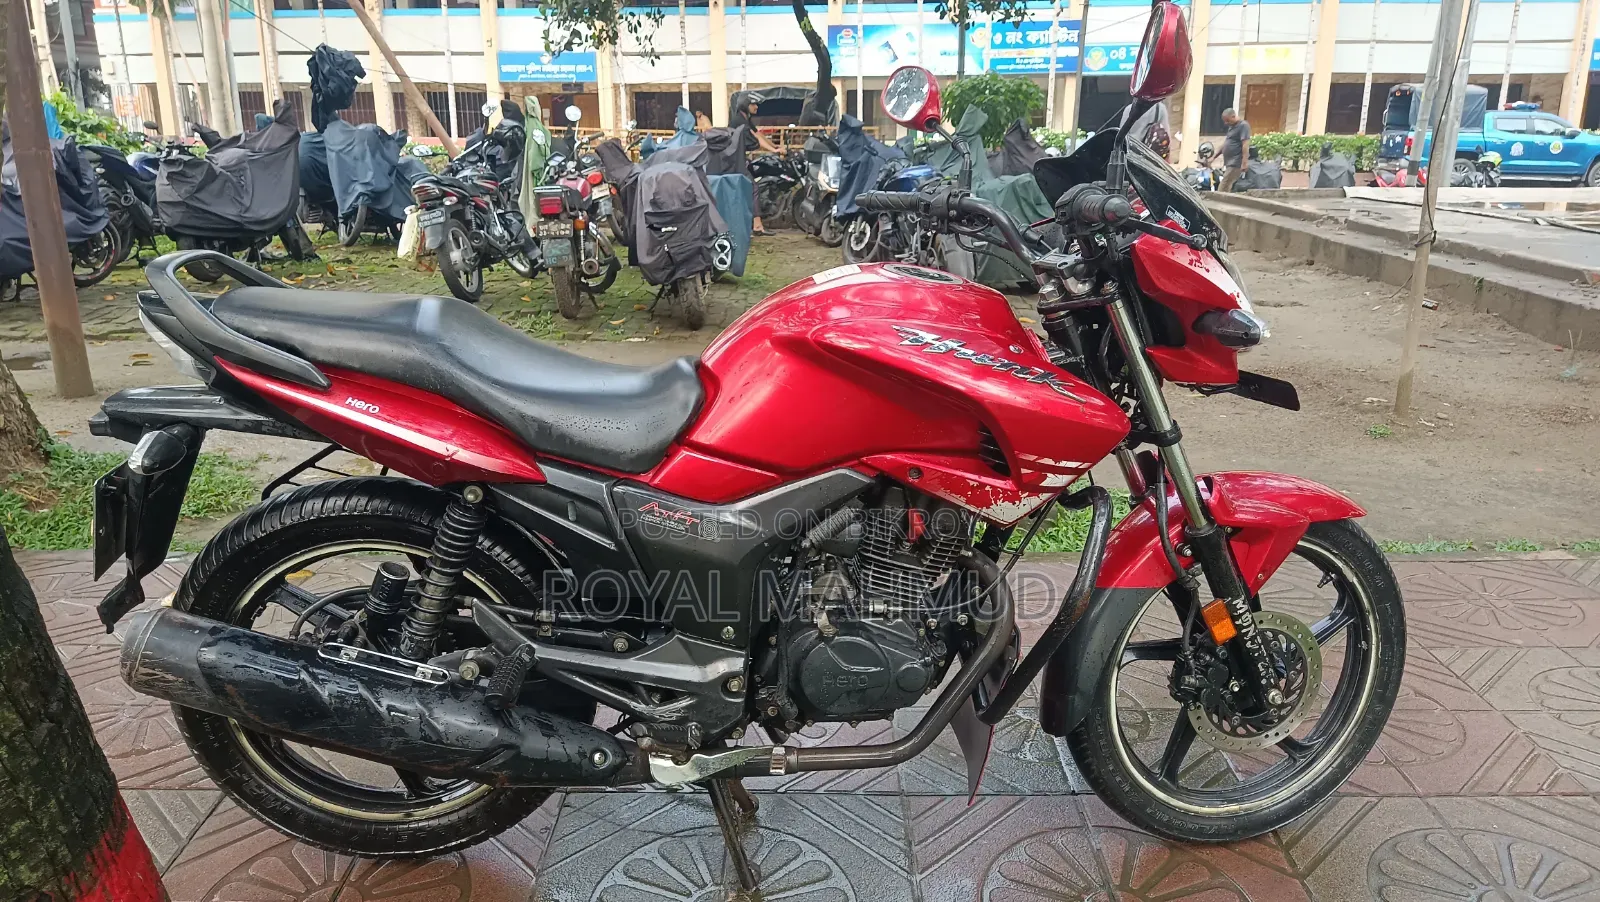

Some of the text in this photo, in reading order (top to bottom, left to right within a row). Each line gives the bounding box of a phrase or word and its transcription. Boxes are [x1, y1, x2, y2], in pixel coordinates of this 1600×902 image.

[1005, 31, 1024, 45] নং
[891, 325, 1087, 403] Hunk
[345, 396, 380, 414] Hero
